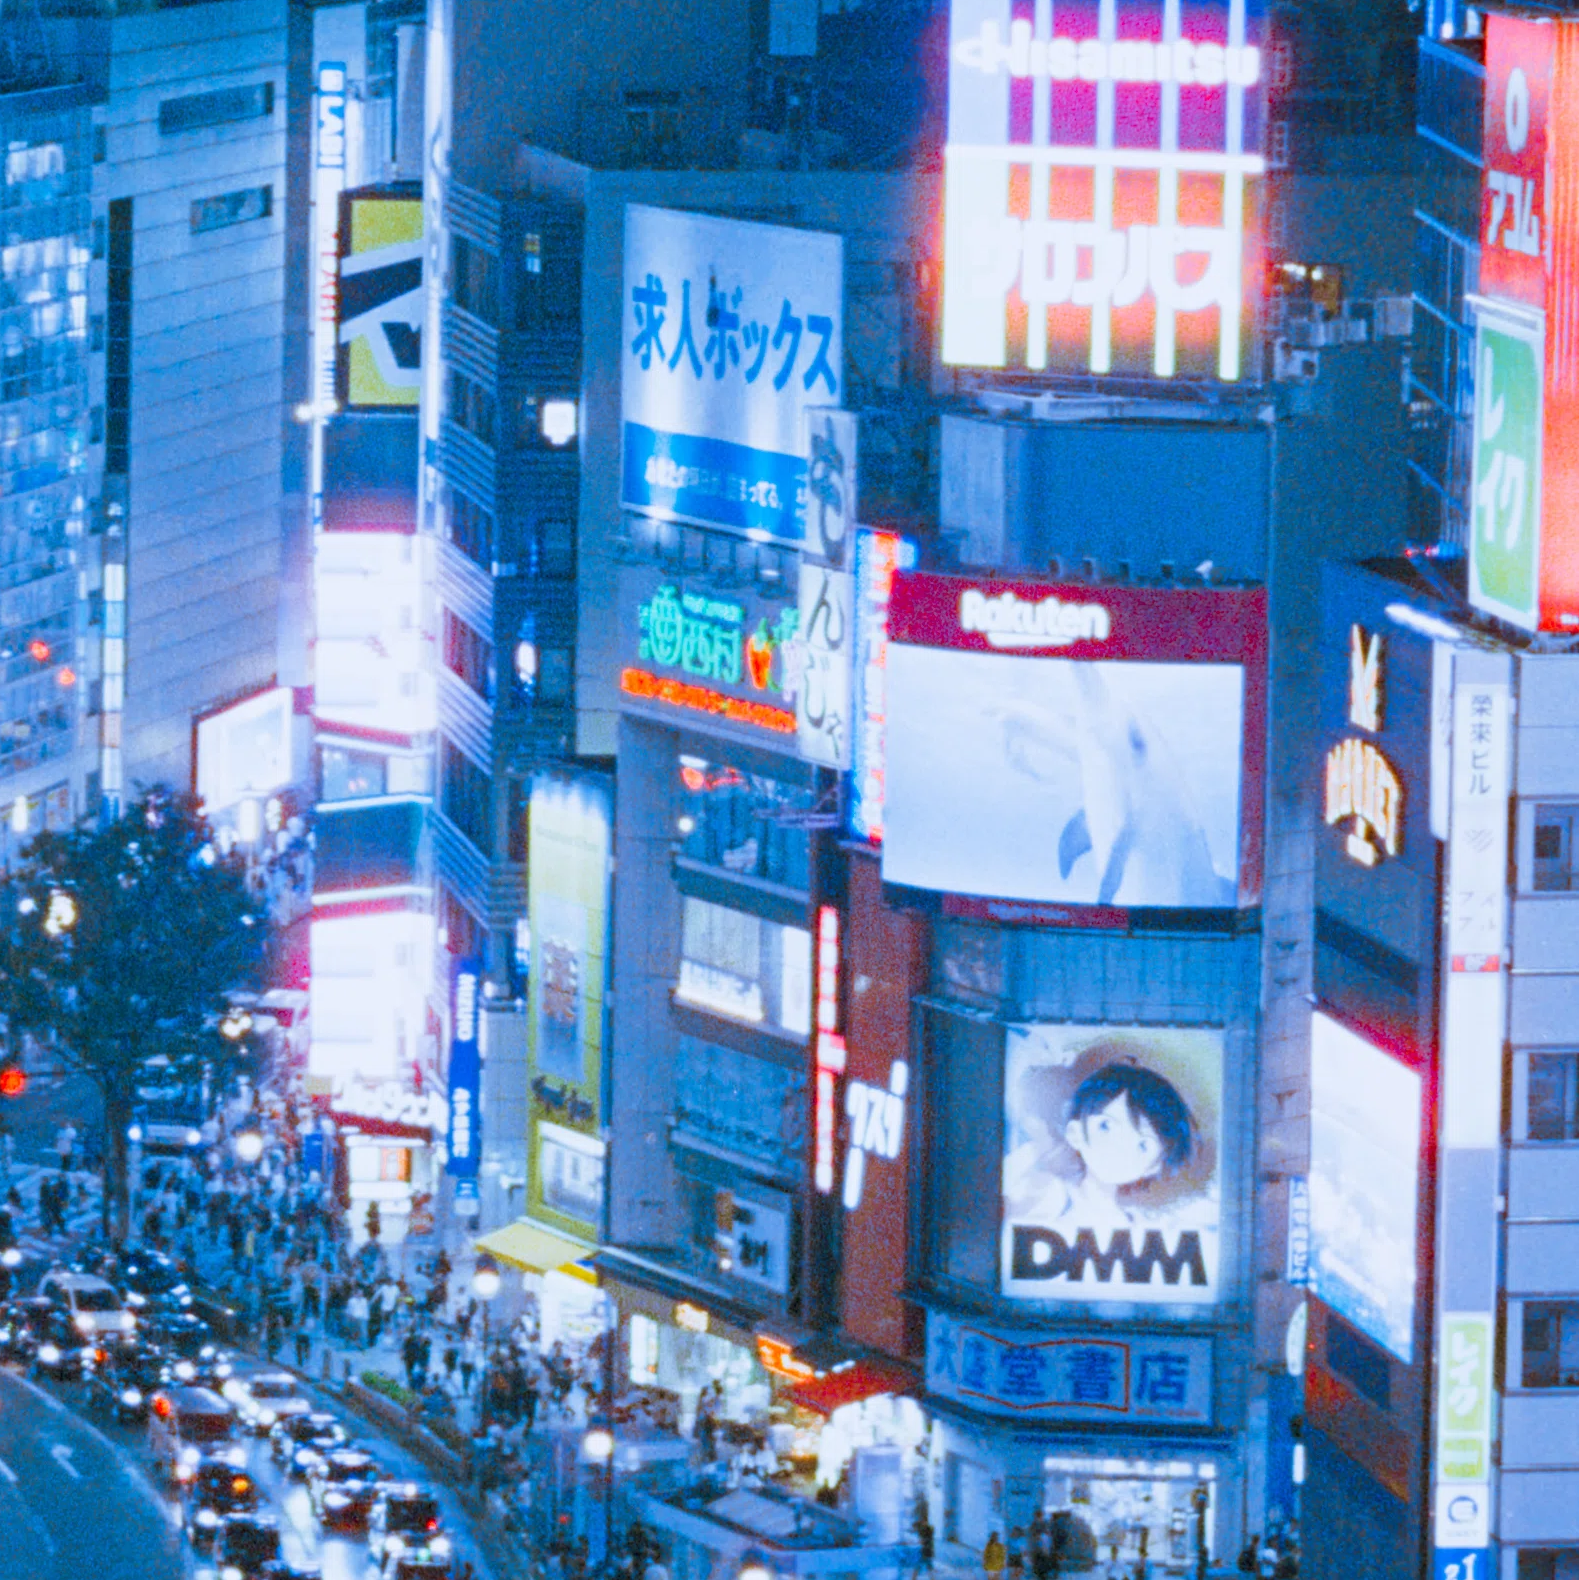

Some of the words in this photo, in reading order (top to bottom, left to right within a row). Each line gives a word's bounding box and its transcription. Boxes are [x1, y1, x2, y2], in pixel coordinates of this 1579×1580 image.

[955, 18, 1260, 86] Hisamitsu
[630, 272, 839, 397] 求人ボックス
[960, 589, 1110, 645] Rakuten
[1010, 1224, 1209, 1286] DMM
[1446, 1330, 1481, 1418] レイク
